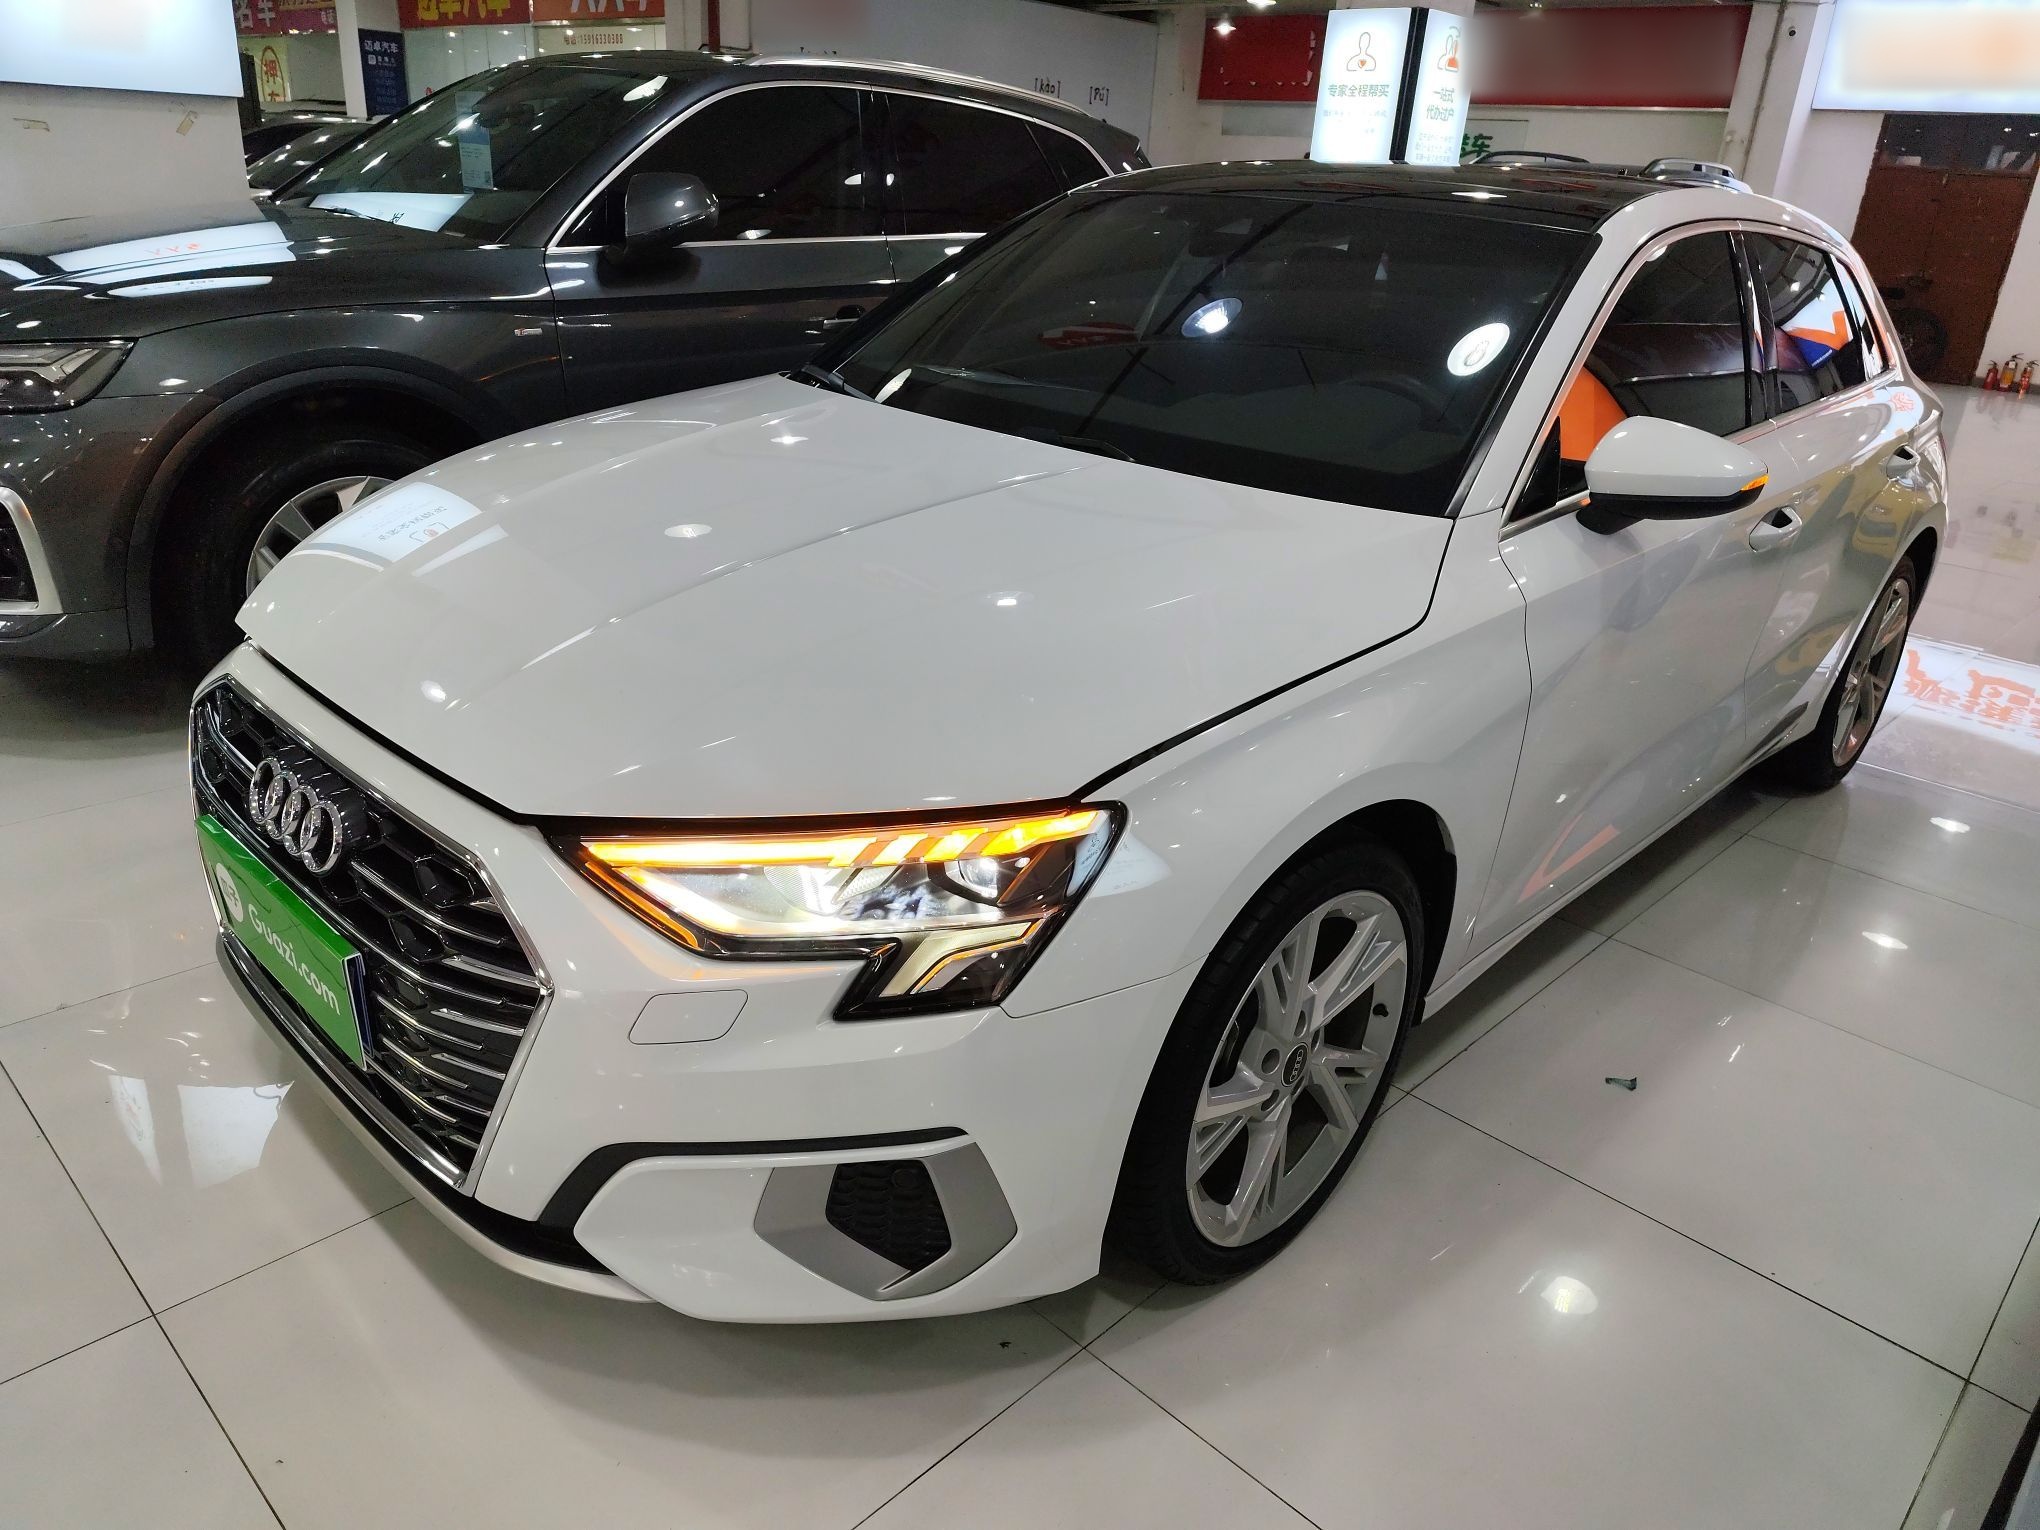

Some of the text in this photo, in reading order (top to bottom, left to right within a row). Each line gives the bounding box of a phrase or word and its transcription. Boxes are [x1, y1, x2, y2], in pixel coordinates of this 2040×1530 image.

[1328, 84, 1390, 97] 专家全程帮买
[248, 903, 342, 1016] Guazi.com
